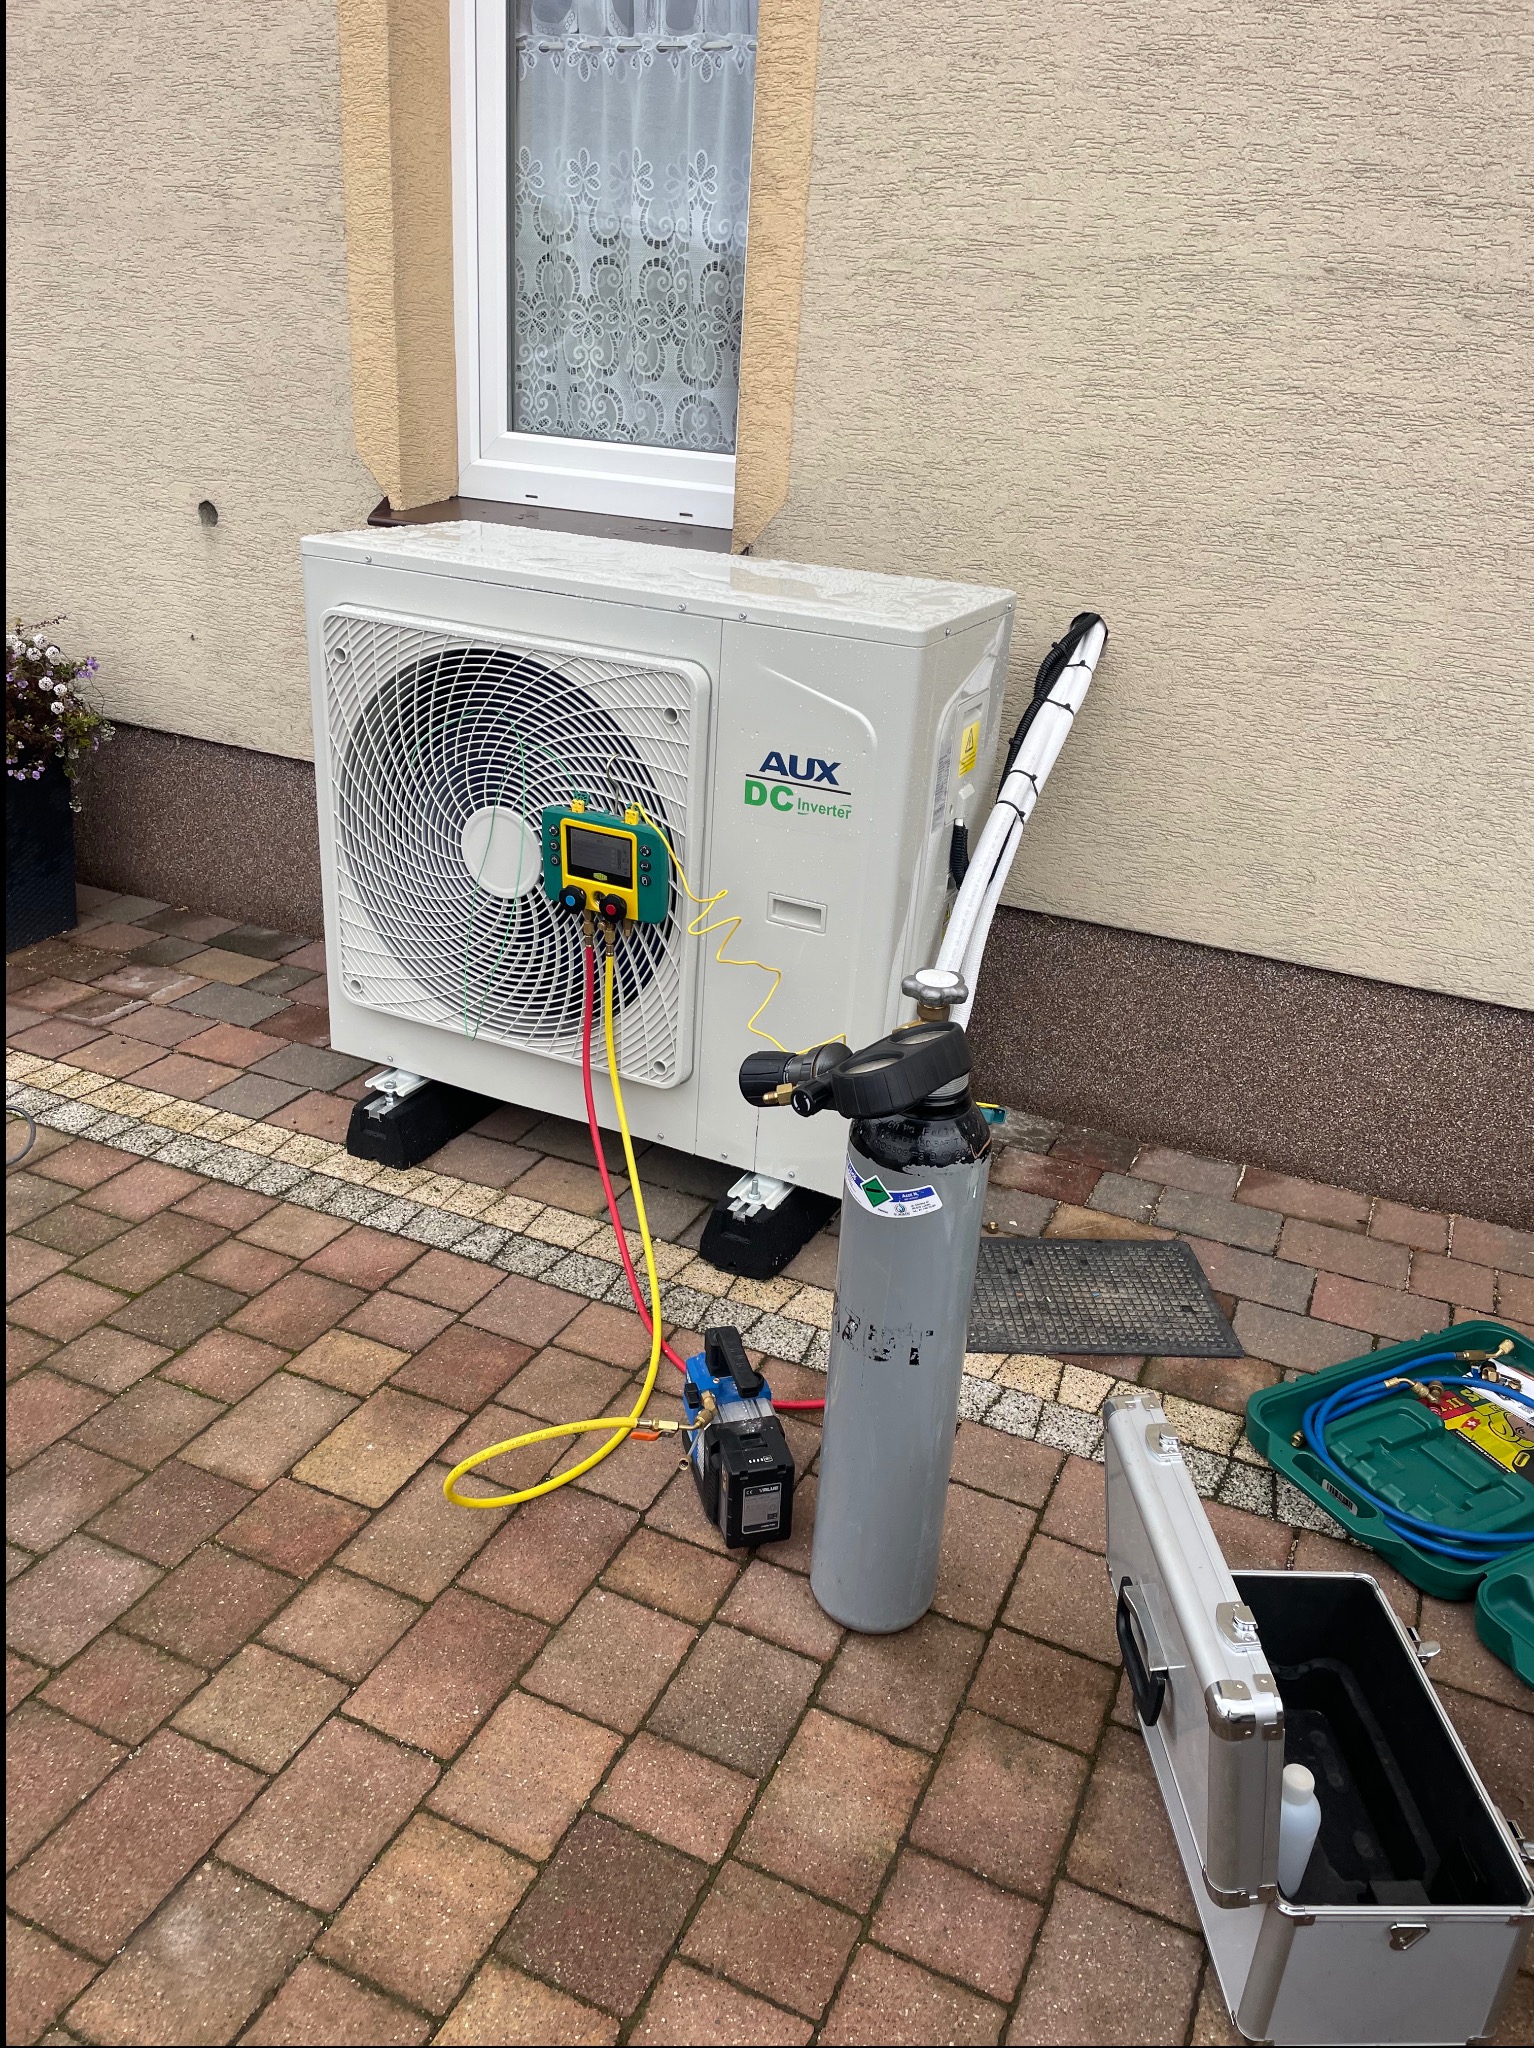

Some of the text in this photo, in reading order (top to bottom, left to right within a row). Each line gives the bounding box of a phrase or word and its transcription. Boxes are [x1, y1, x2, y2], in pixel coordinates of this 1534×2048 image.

[759, 751, 842, 786] AUX
[744, 779, 852, 819] DC Inverter
